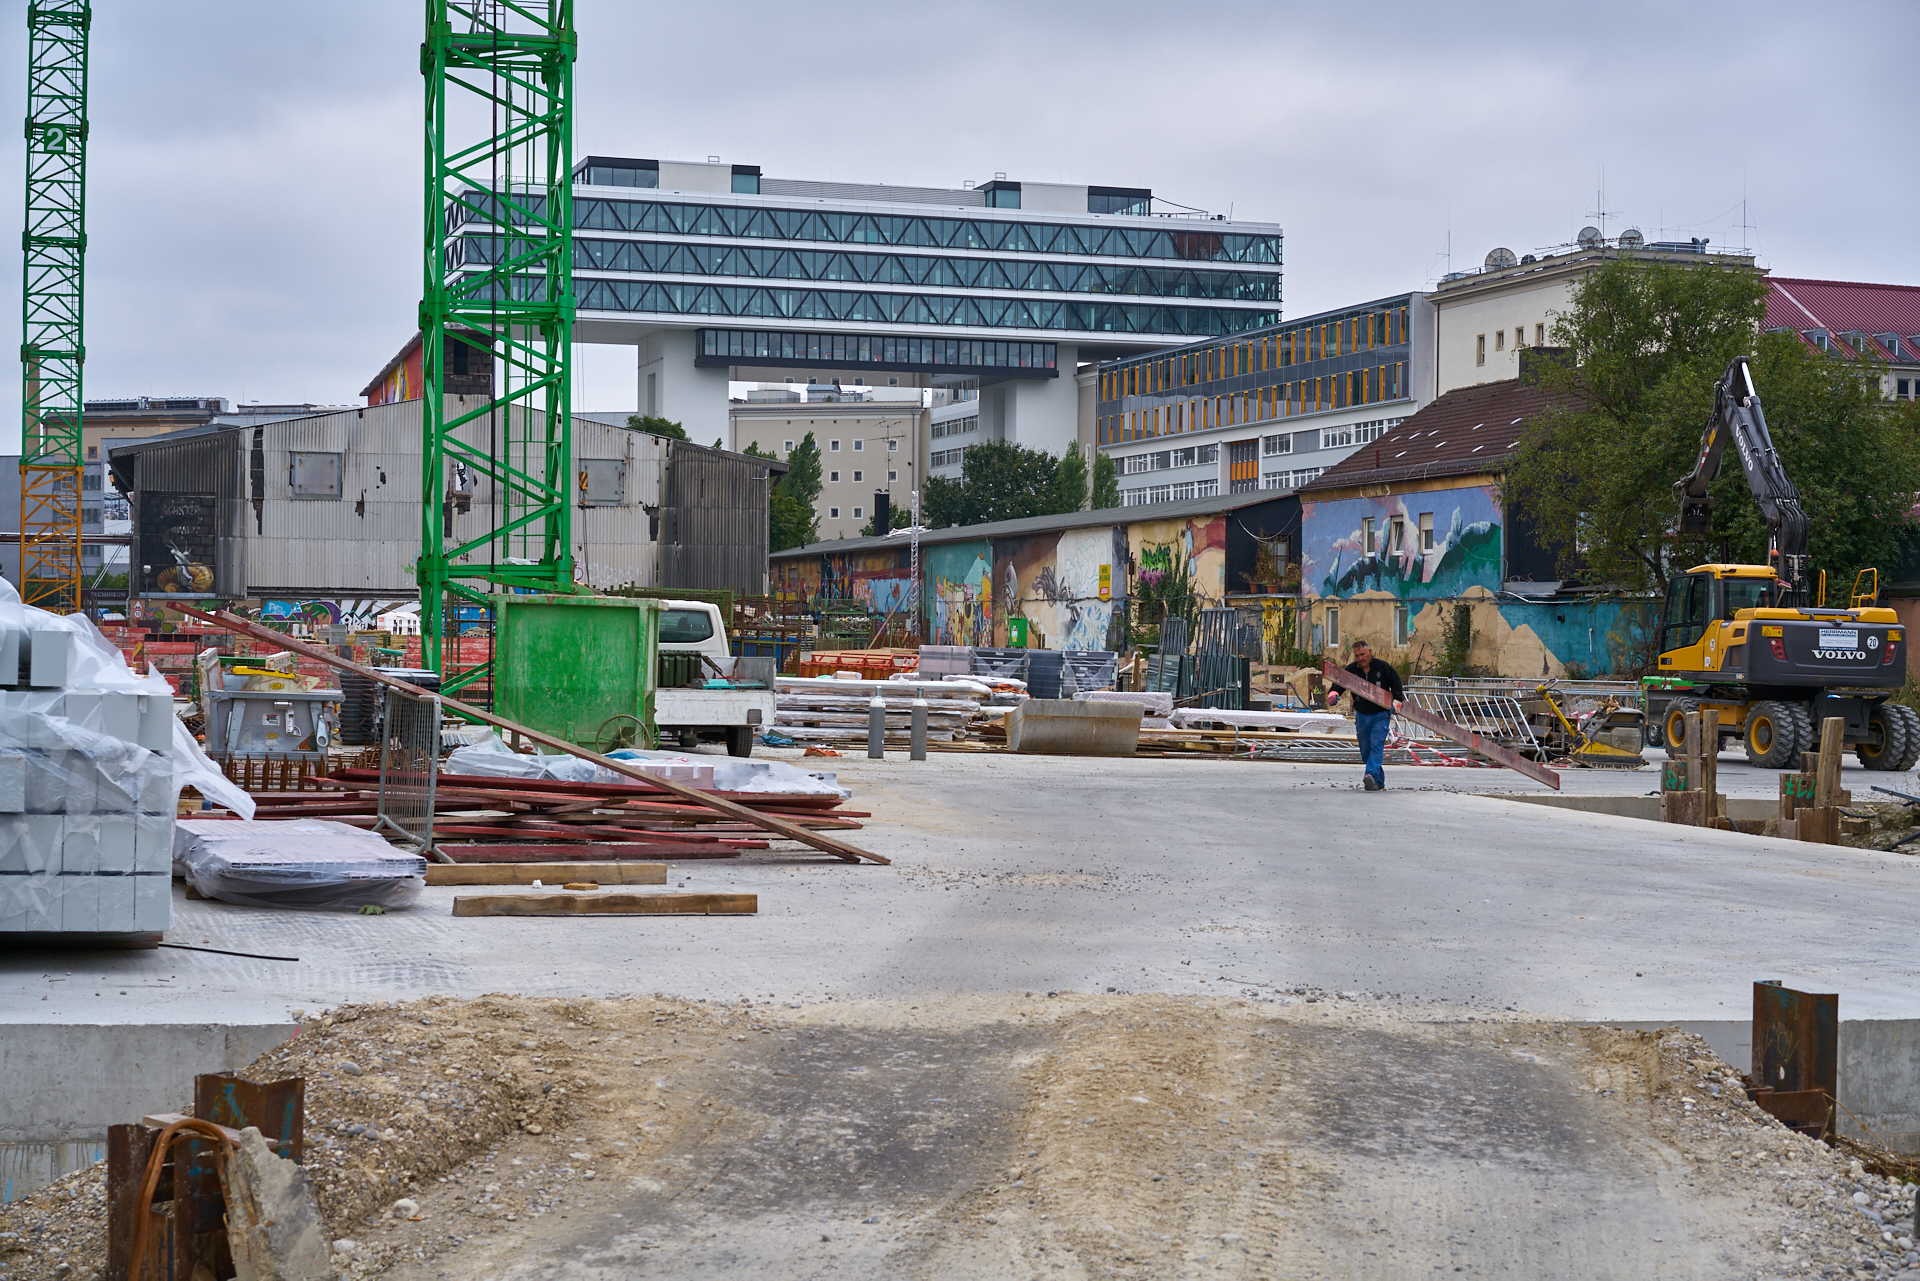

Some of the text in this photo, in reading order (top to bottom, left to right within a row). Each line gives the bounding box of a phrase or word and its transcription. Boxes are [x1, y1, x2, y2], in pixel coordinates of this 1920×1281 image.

[46, 127, 64, 151] 2
[1869, 638, 1877, 647] 20
[1811, 649, 1867, 660] VOLVO
